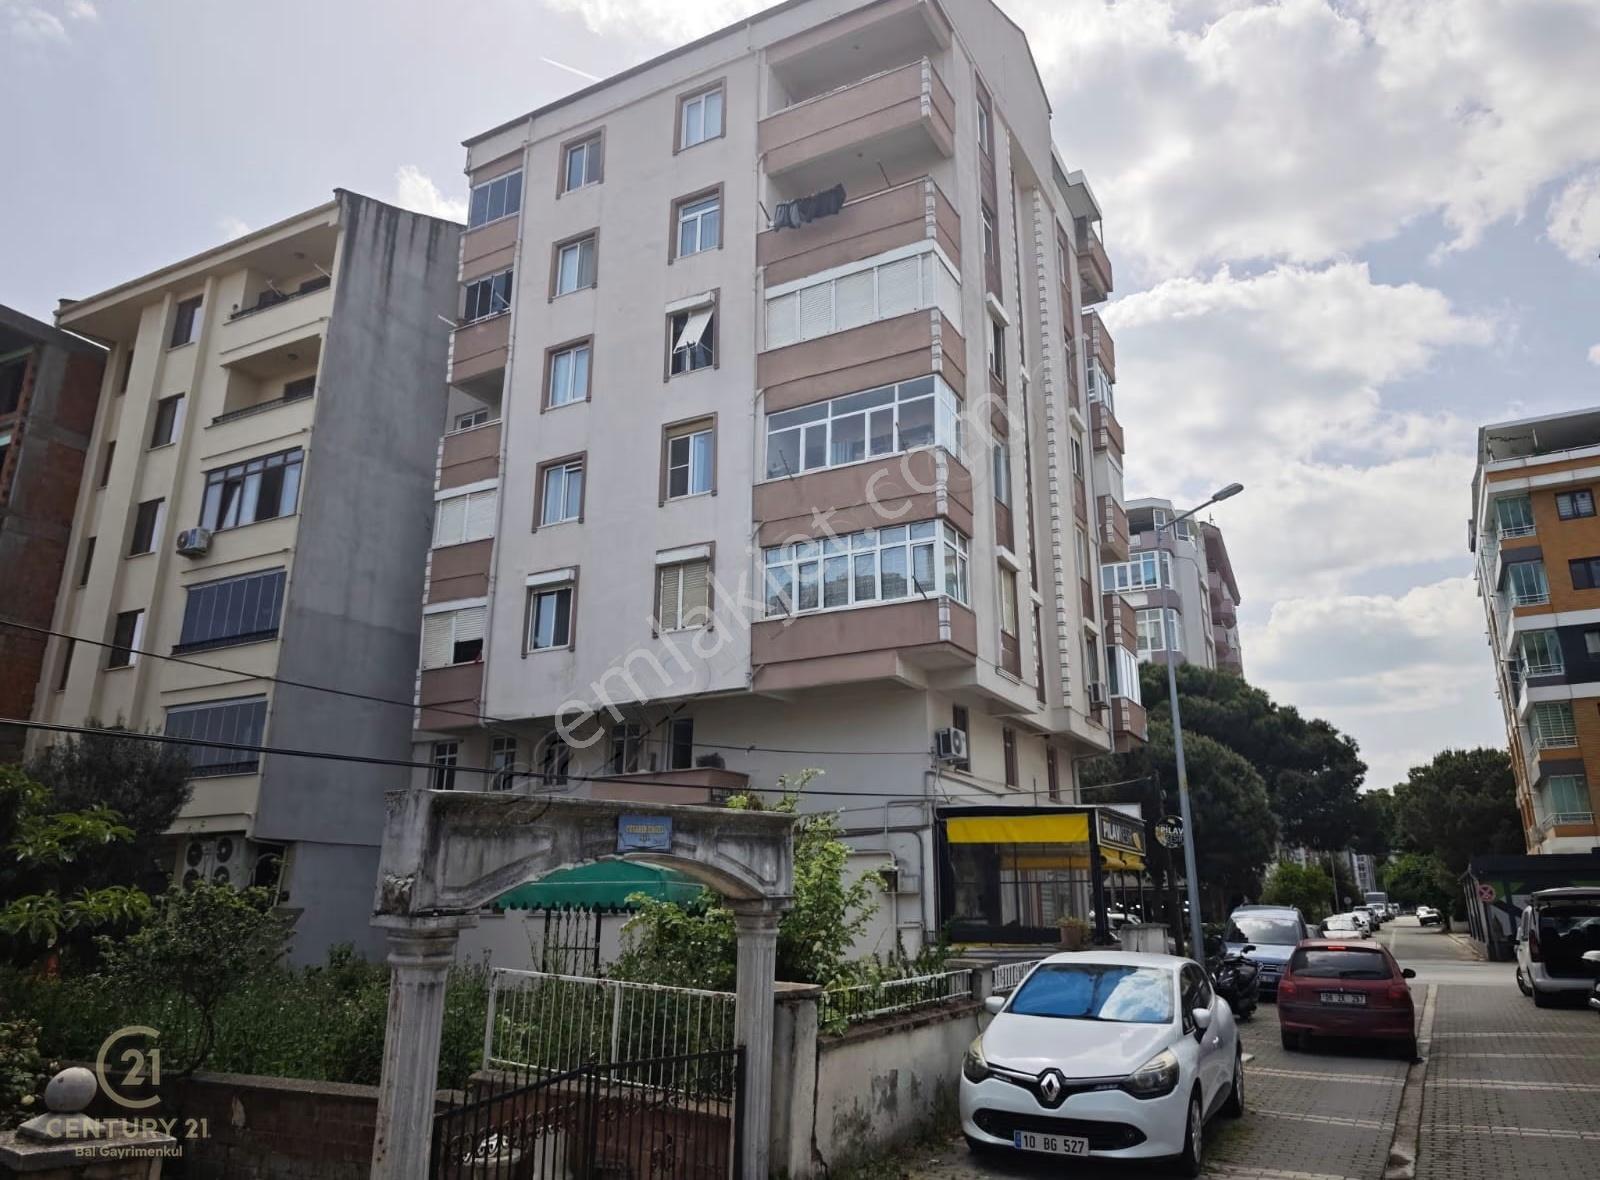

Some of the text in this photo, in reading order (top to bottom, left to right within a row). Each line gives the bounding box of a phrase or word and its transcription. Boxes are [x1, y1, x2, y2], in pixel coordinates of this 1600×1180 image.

[1023, 1135, 1085, 1154] 10 BG 527
